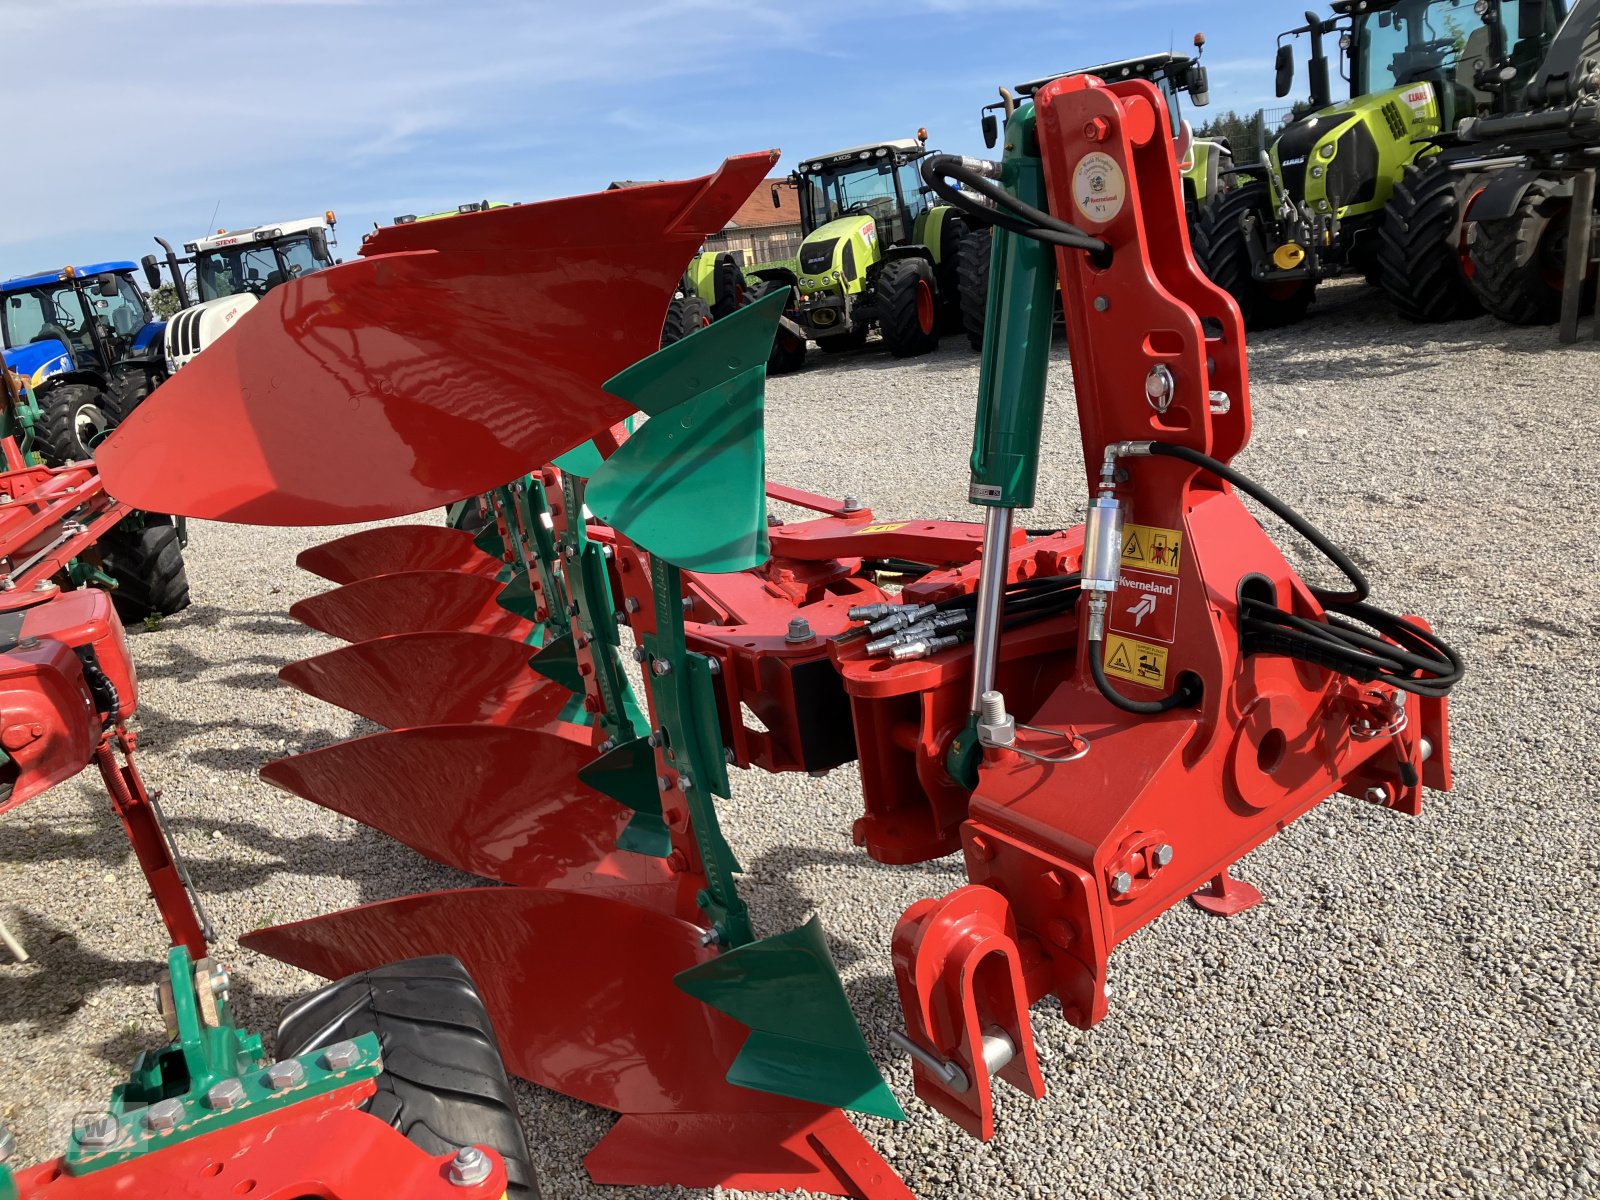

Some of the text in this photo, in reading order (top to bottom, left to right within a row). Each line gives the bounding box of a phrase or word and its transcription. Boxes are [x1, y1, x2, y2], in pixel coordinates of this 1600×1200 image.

[1408, 92, 1428, 103] CLAAS
[833, 154, 852, 162] AXOS
[1282, 157, 1305, 167] CLAAS
[862, 223, 874, 236] CLAAS
[215, 238, 237, 247] STEYR
[225, 307, 238, 322] STEYR
[1119, 575, 1173, 595] Kverneland
